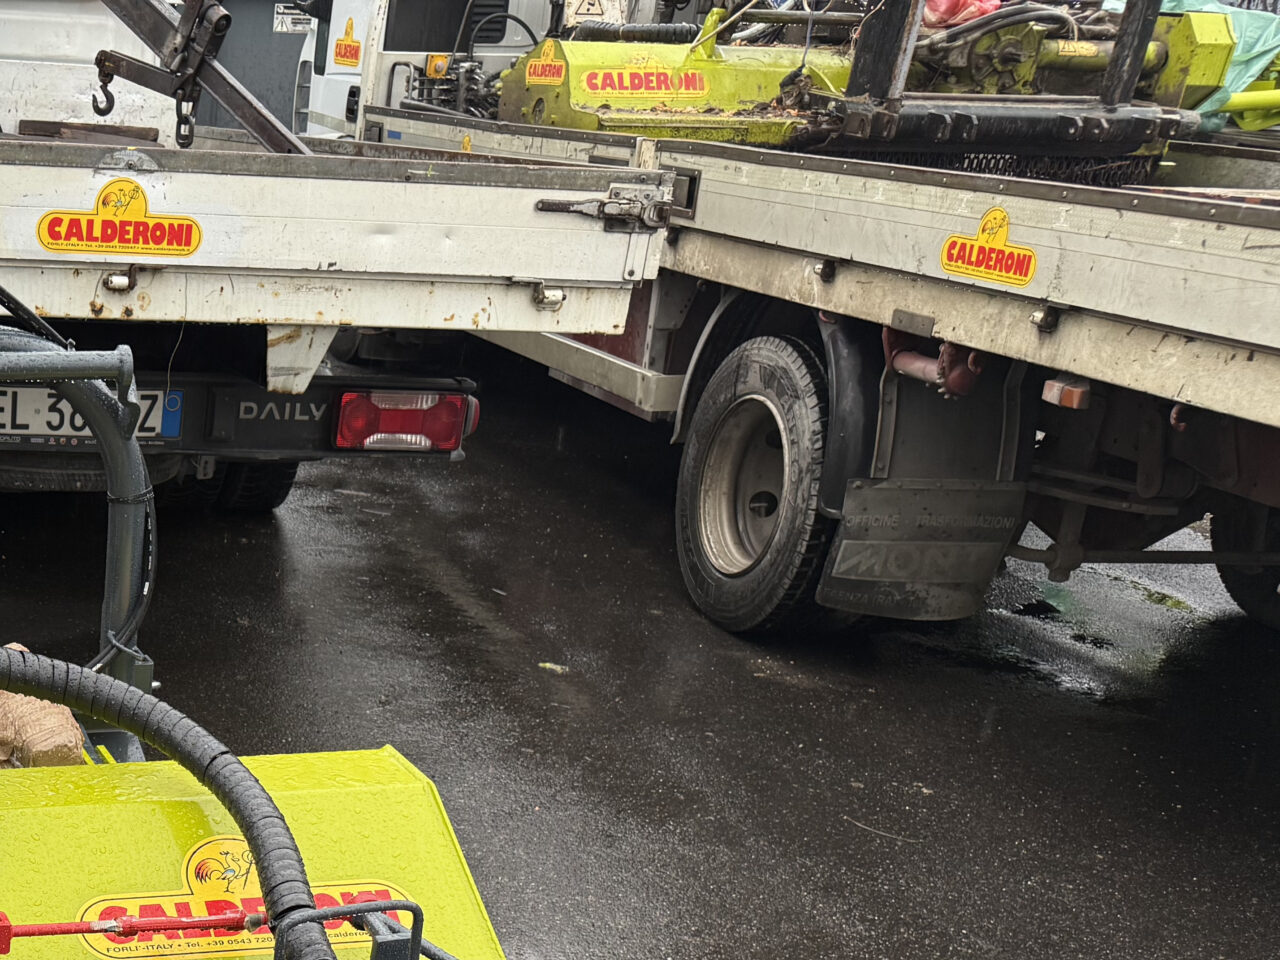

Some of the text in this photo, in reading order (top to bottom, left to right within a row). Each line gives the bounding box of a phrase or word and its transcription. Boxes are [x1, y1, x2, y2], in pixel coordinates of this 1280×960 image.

[528, 63, 564, 79] CALDERONI
[586, 72, 705, 91] CALDERONI
[47, 216, 194, 247] CALDERONI
[946, 240, 1033, 278] CALDERONI
[239, 401, 327, 421] DAILY
[845, 514, 900, 528] OFFICINE
[185, 941, 203, 949] Tel.
[206, 939, 225, 947] +39
[255, 936, 275, 944] 720
